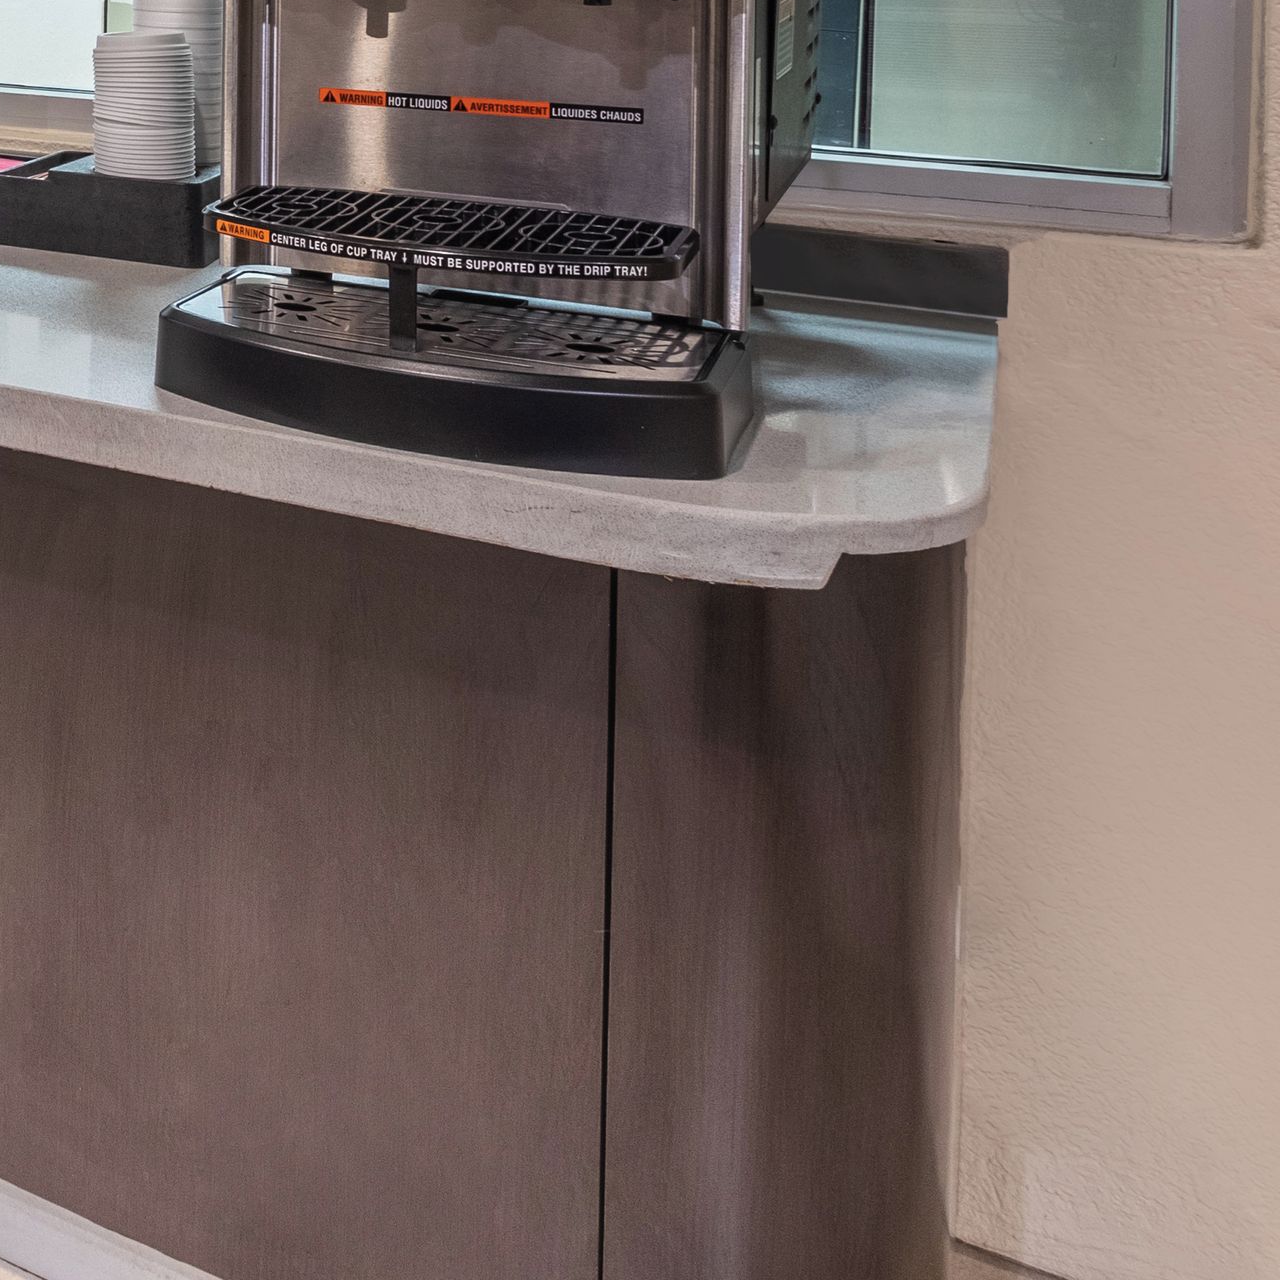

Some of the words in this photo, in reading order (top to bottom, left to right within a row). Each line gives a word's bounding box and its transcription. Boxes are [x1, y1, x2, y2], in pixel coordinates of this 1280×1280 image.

[339, 92, 383, 106] WARNING
[388, 97, 406, 107] HOT
[409, 97, 448, 110] LIQUIDS
[469, 101, 548, 115] AVERTISSEMENT
[551, 107, 597, 119] LIQUIDES
[600, 110, 641, 122] CHAUDS
[228, 223, 265, 240] WARNING
[271, 232, 306, 249] CENTER
[308, 239, 328, 252] LEG
[330, 243, 344, 254] OF
[346, 245, 367, 258] CUP
[369, 248, 397, 262] TRAY
[413, 253, 444, 267] MUST
[447, 257, 462, 269] BE
[465, 259, 535, 274] SUPPORTED
[538, 263, 554, 275] BY
[557, 264, 581, 276] THE
[584, 265, 611, 277] DRIP
[614, 265, 648, 277] TRAY!
